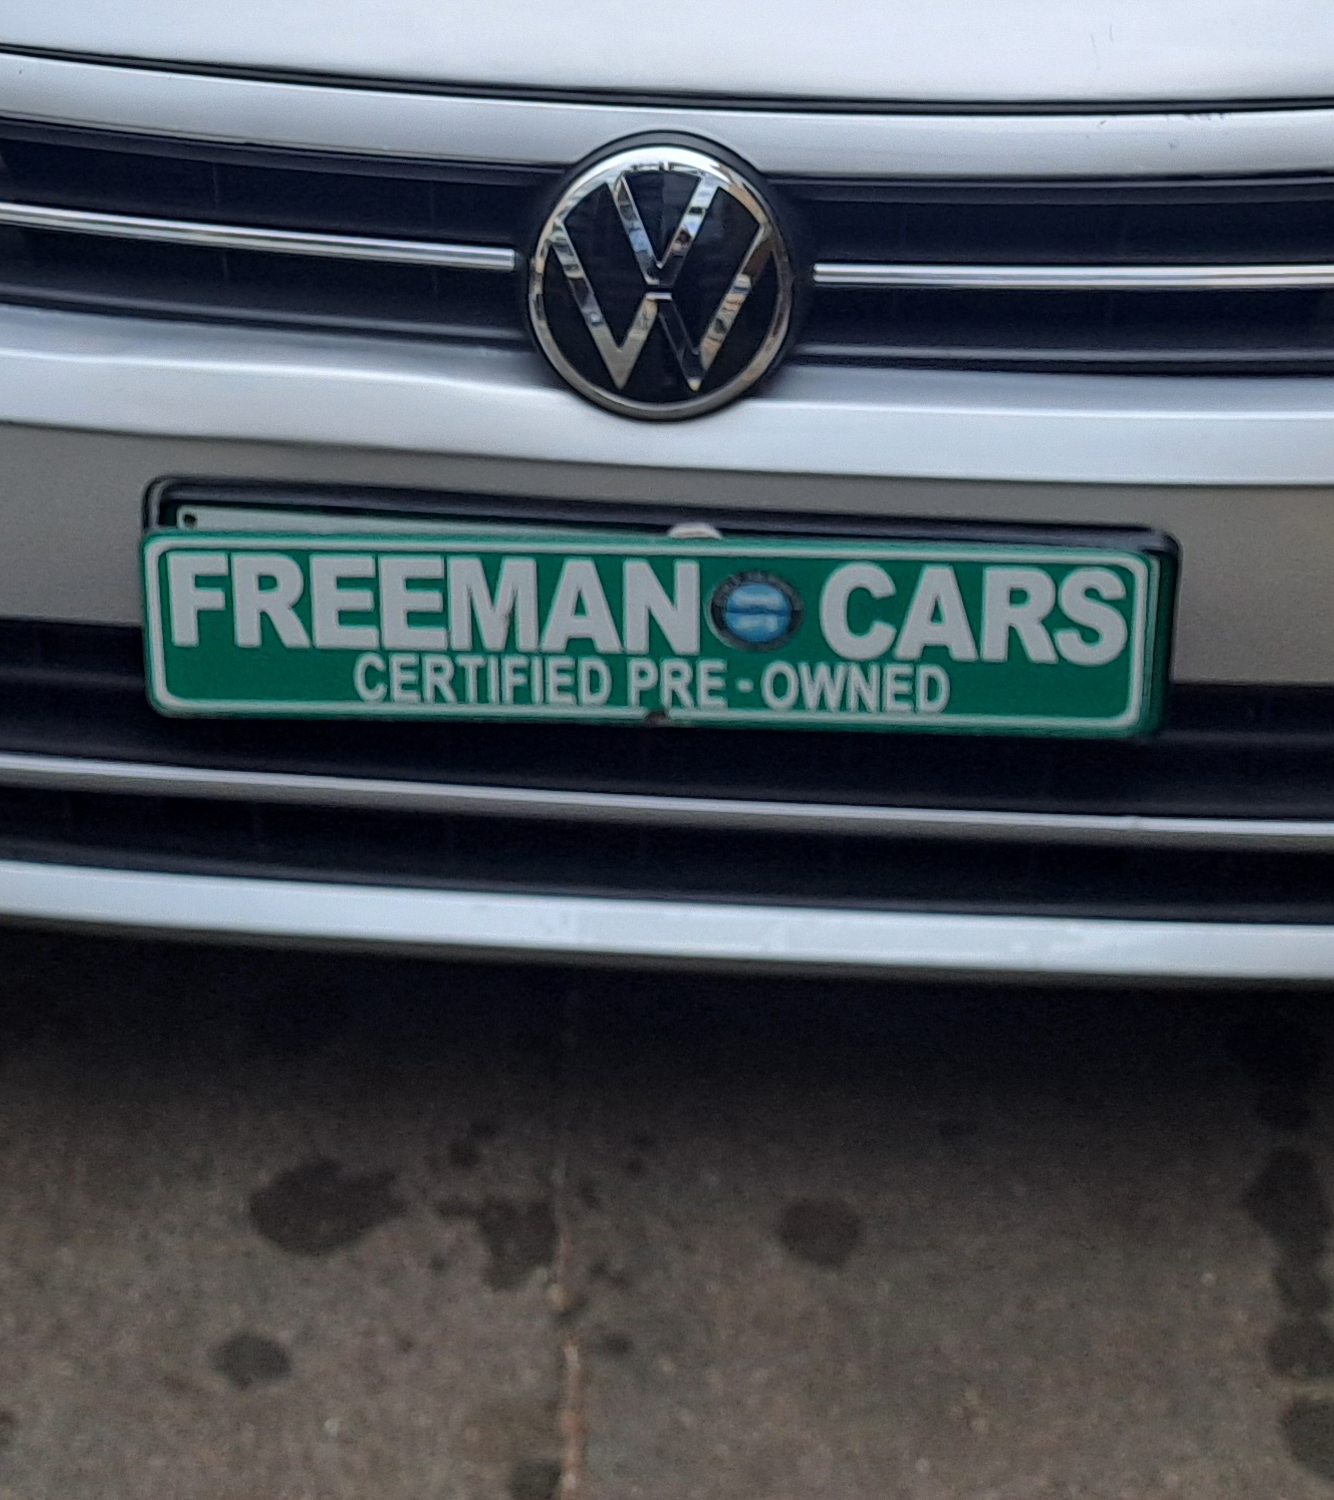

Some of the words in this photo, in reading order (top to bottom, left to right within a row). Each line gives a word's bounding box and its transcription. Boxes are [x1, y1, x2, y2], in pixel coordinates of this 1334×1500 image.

[168, 551, 701, 656] FREEMAN
[819, 561, 1129, 668] CARS
[353, 650, 613, 708] CERTIFIED
